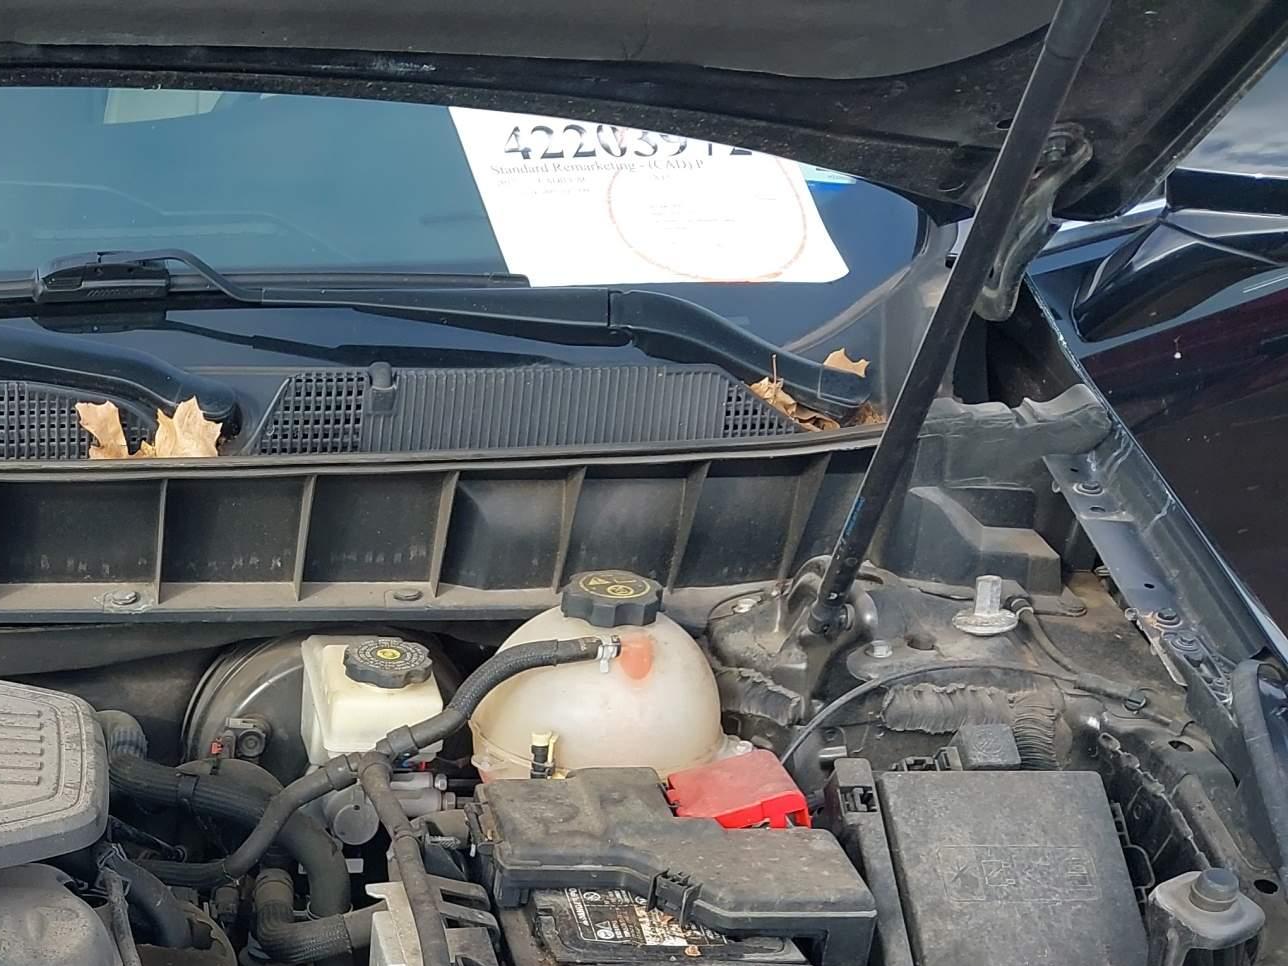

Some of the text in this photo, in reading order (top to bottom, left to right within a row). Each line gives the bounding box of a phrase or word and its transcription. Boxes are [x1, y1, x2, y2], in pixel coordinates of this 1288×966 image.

[503, 125, 753, 160] 422039
[490, 163, 549, 175] Standard
[552, 160, 638, 173] Remarketing
